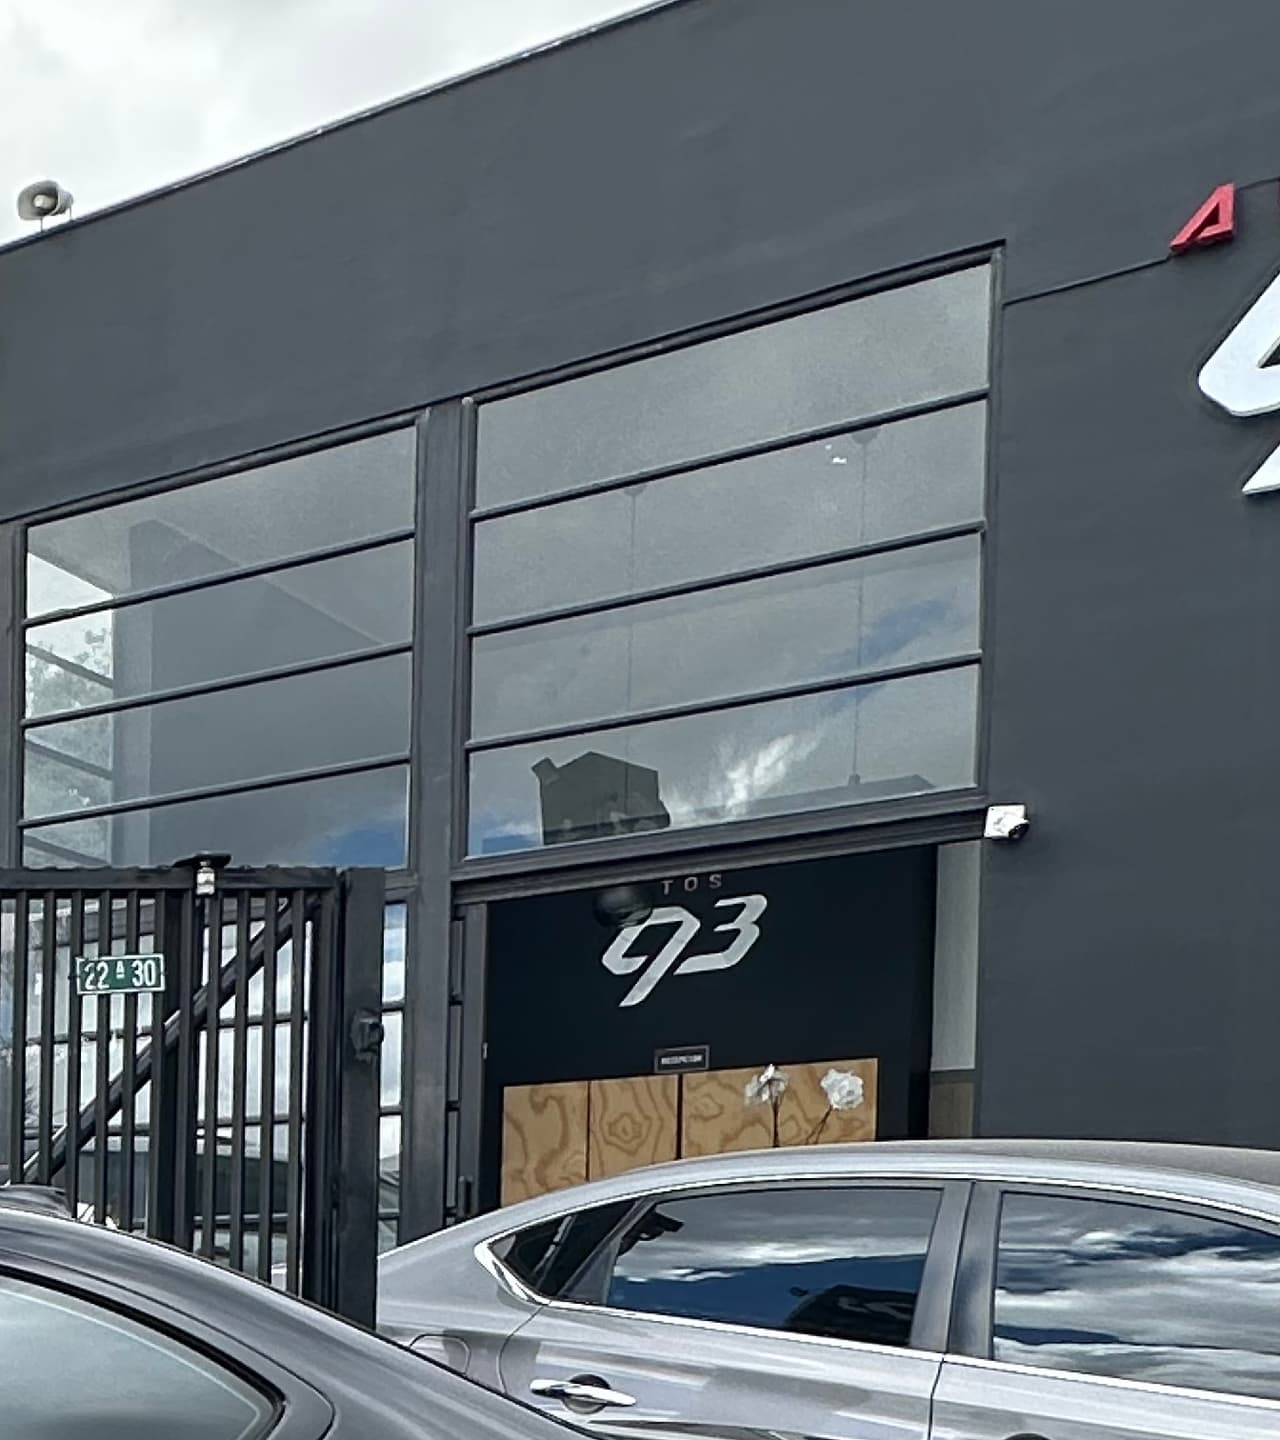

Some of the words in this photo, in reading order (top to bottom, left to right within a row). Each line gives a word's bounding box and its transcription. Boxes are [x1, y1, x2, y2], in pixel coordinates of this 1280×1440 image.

[1168, 181, 1237, 253] A
[83, 961, 110, 990] 22
[130, 959, 156, 987] 30
[601, 894, 768, 1008] 93
